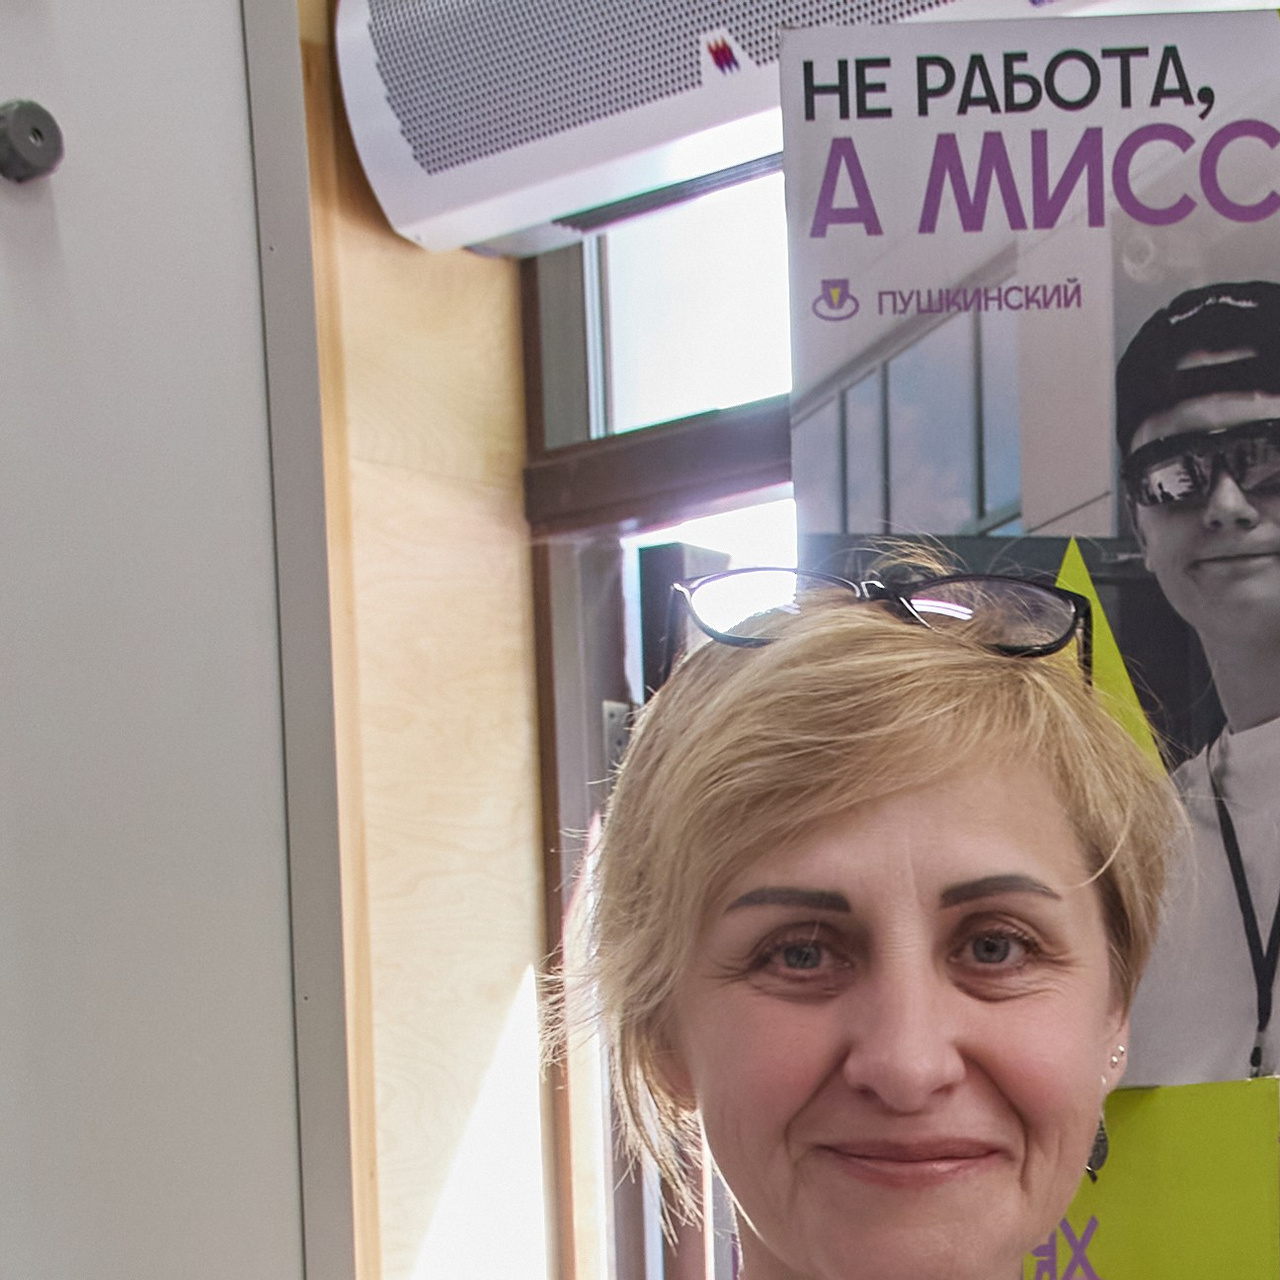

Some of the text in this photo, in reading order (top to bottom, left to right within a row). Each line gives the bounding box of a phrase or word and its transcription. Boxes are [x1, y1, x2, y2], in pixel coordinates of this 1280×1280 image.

[803, 45, 1216, 121] НЕ РАБОТА,
[810, 137, 883, 239] А
[878, 280, 1082, 316] ПУШКИНСКИЙ
